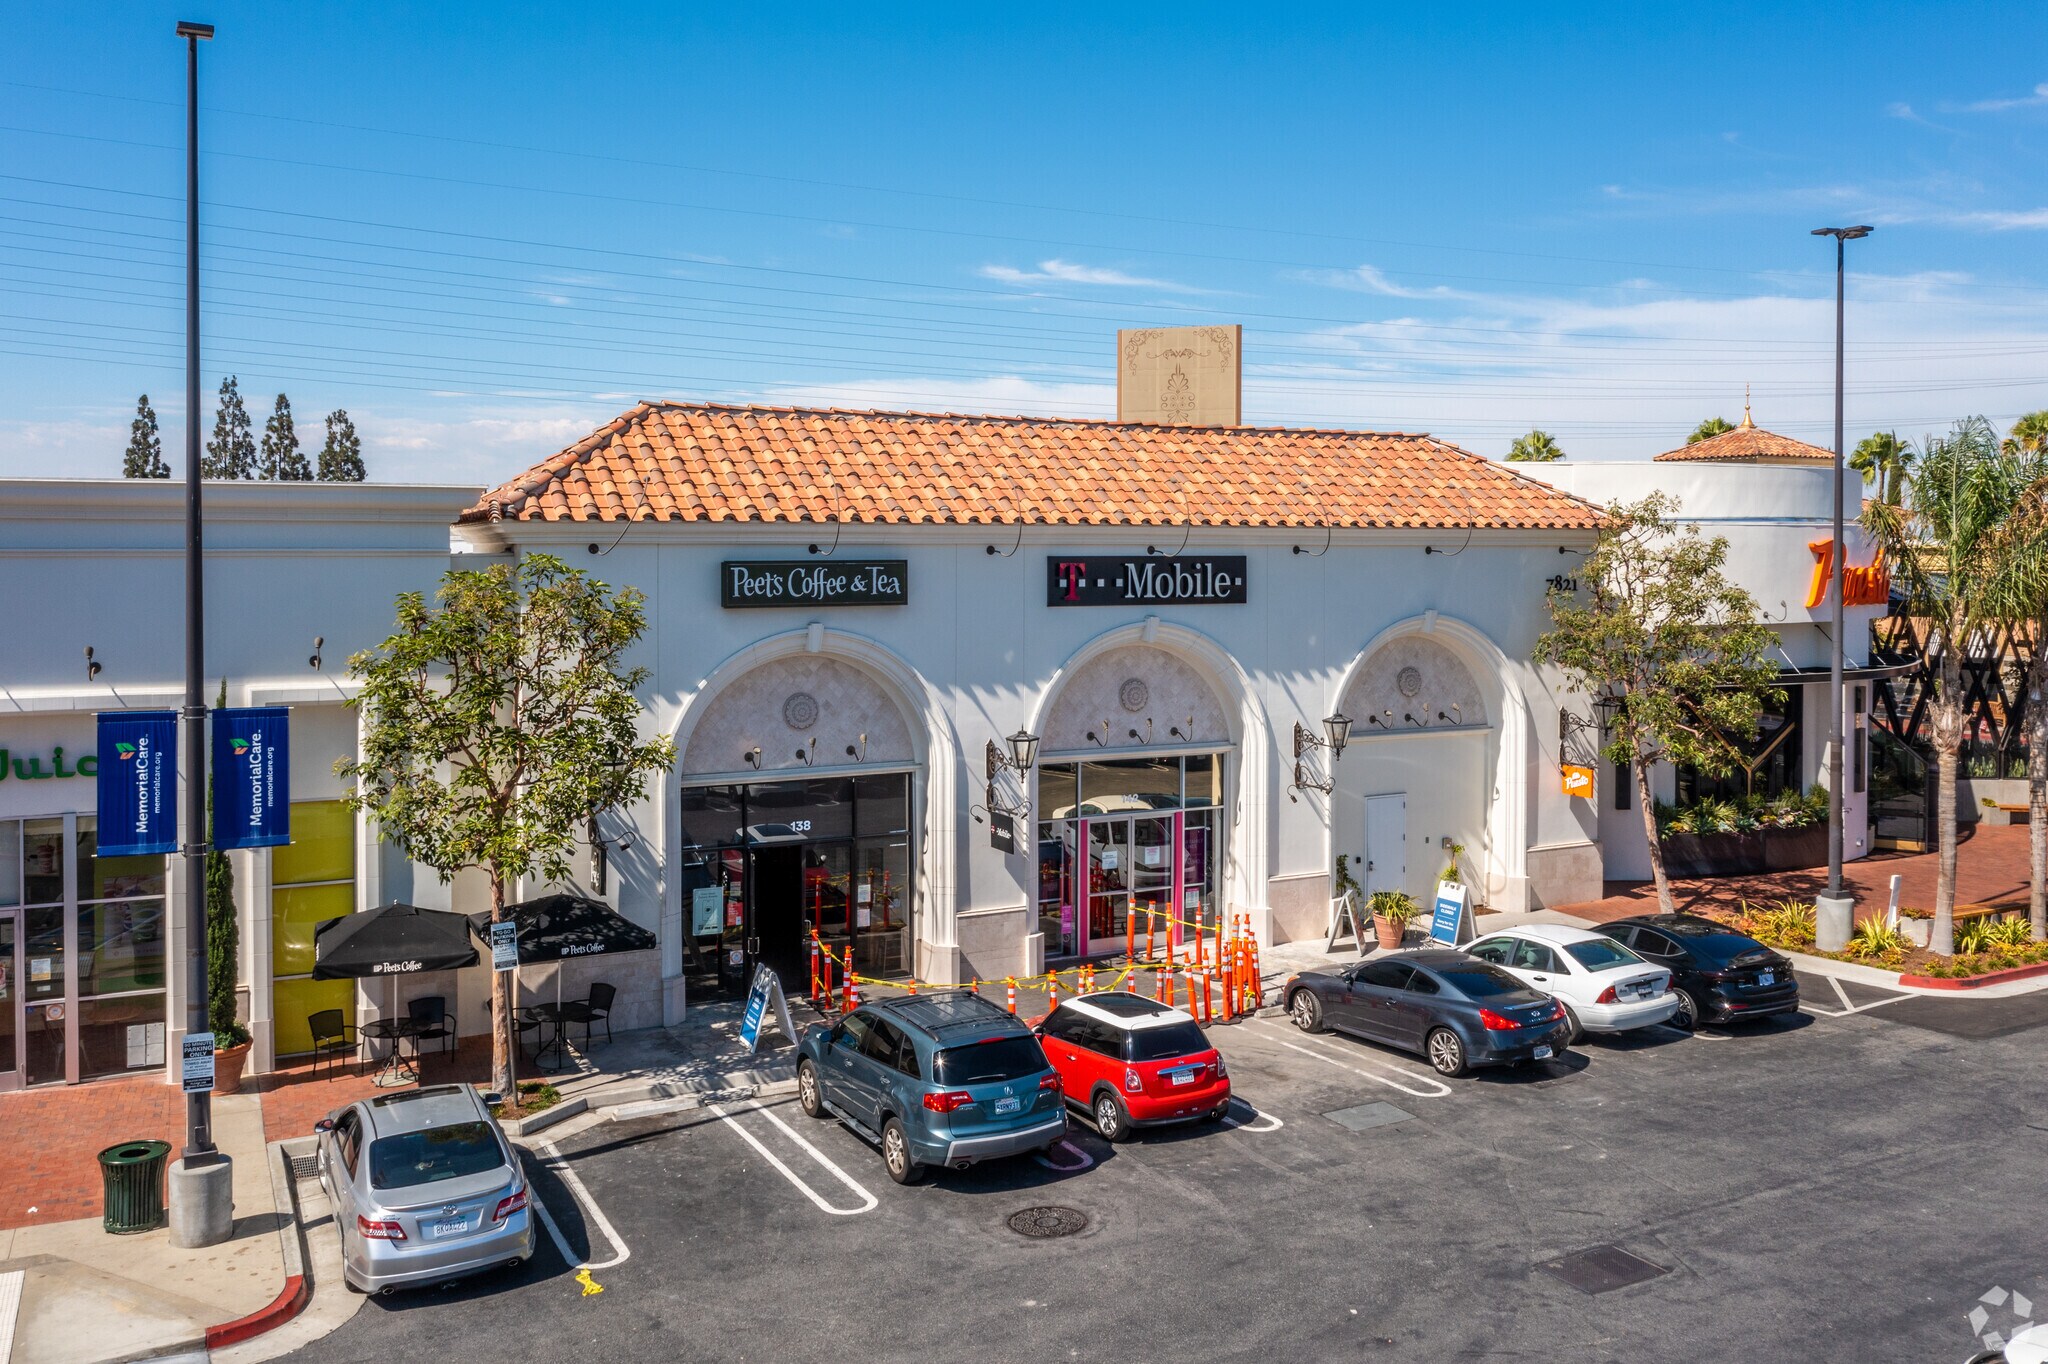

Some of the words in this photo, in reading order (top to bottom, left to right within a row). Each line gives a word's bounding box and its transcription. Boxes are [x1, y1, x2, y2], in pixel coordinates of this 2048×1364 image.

[731, 567, 783, 598] Peet's
[788, 567, 847, 599] Coffee
[850, 575, 868, 592] &
[865, 566, 902, 595] Tea
[1125, 563, 1231, 598] Mobile
[1545, 575, 1578, 595] 7821
[154, 752, 162, 814] memorialcare.org
[790, 820, 811, 831] 138
[586, 942, 605, 953] Coffee
[401, 960, 422, 972] Coffee
